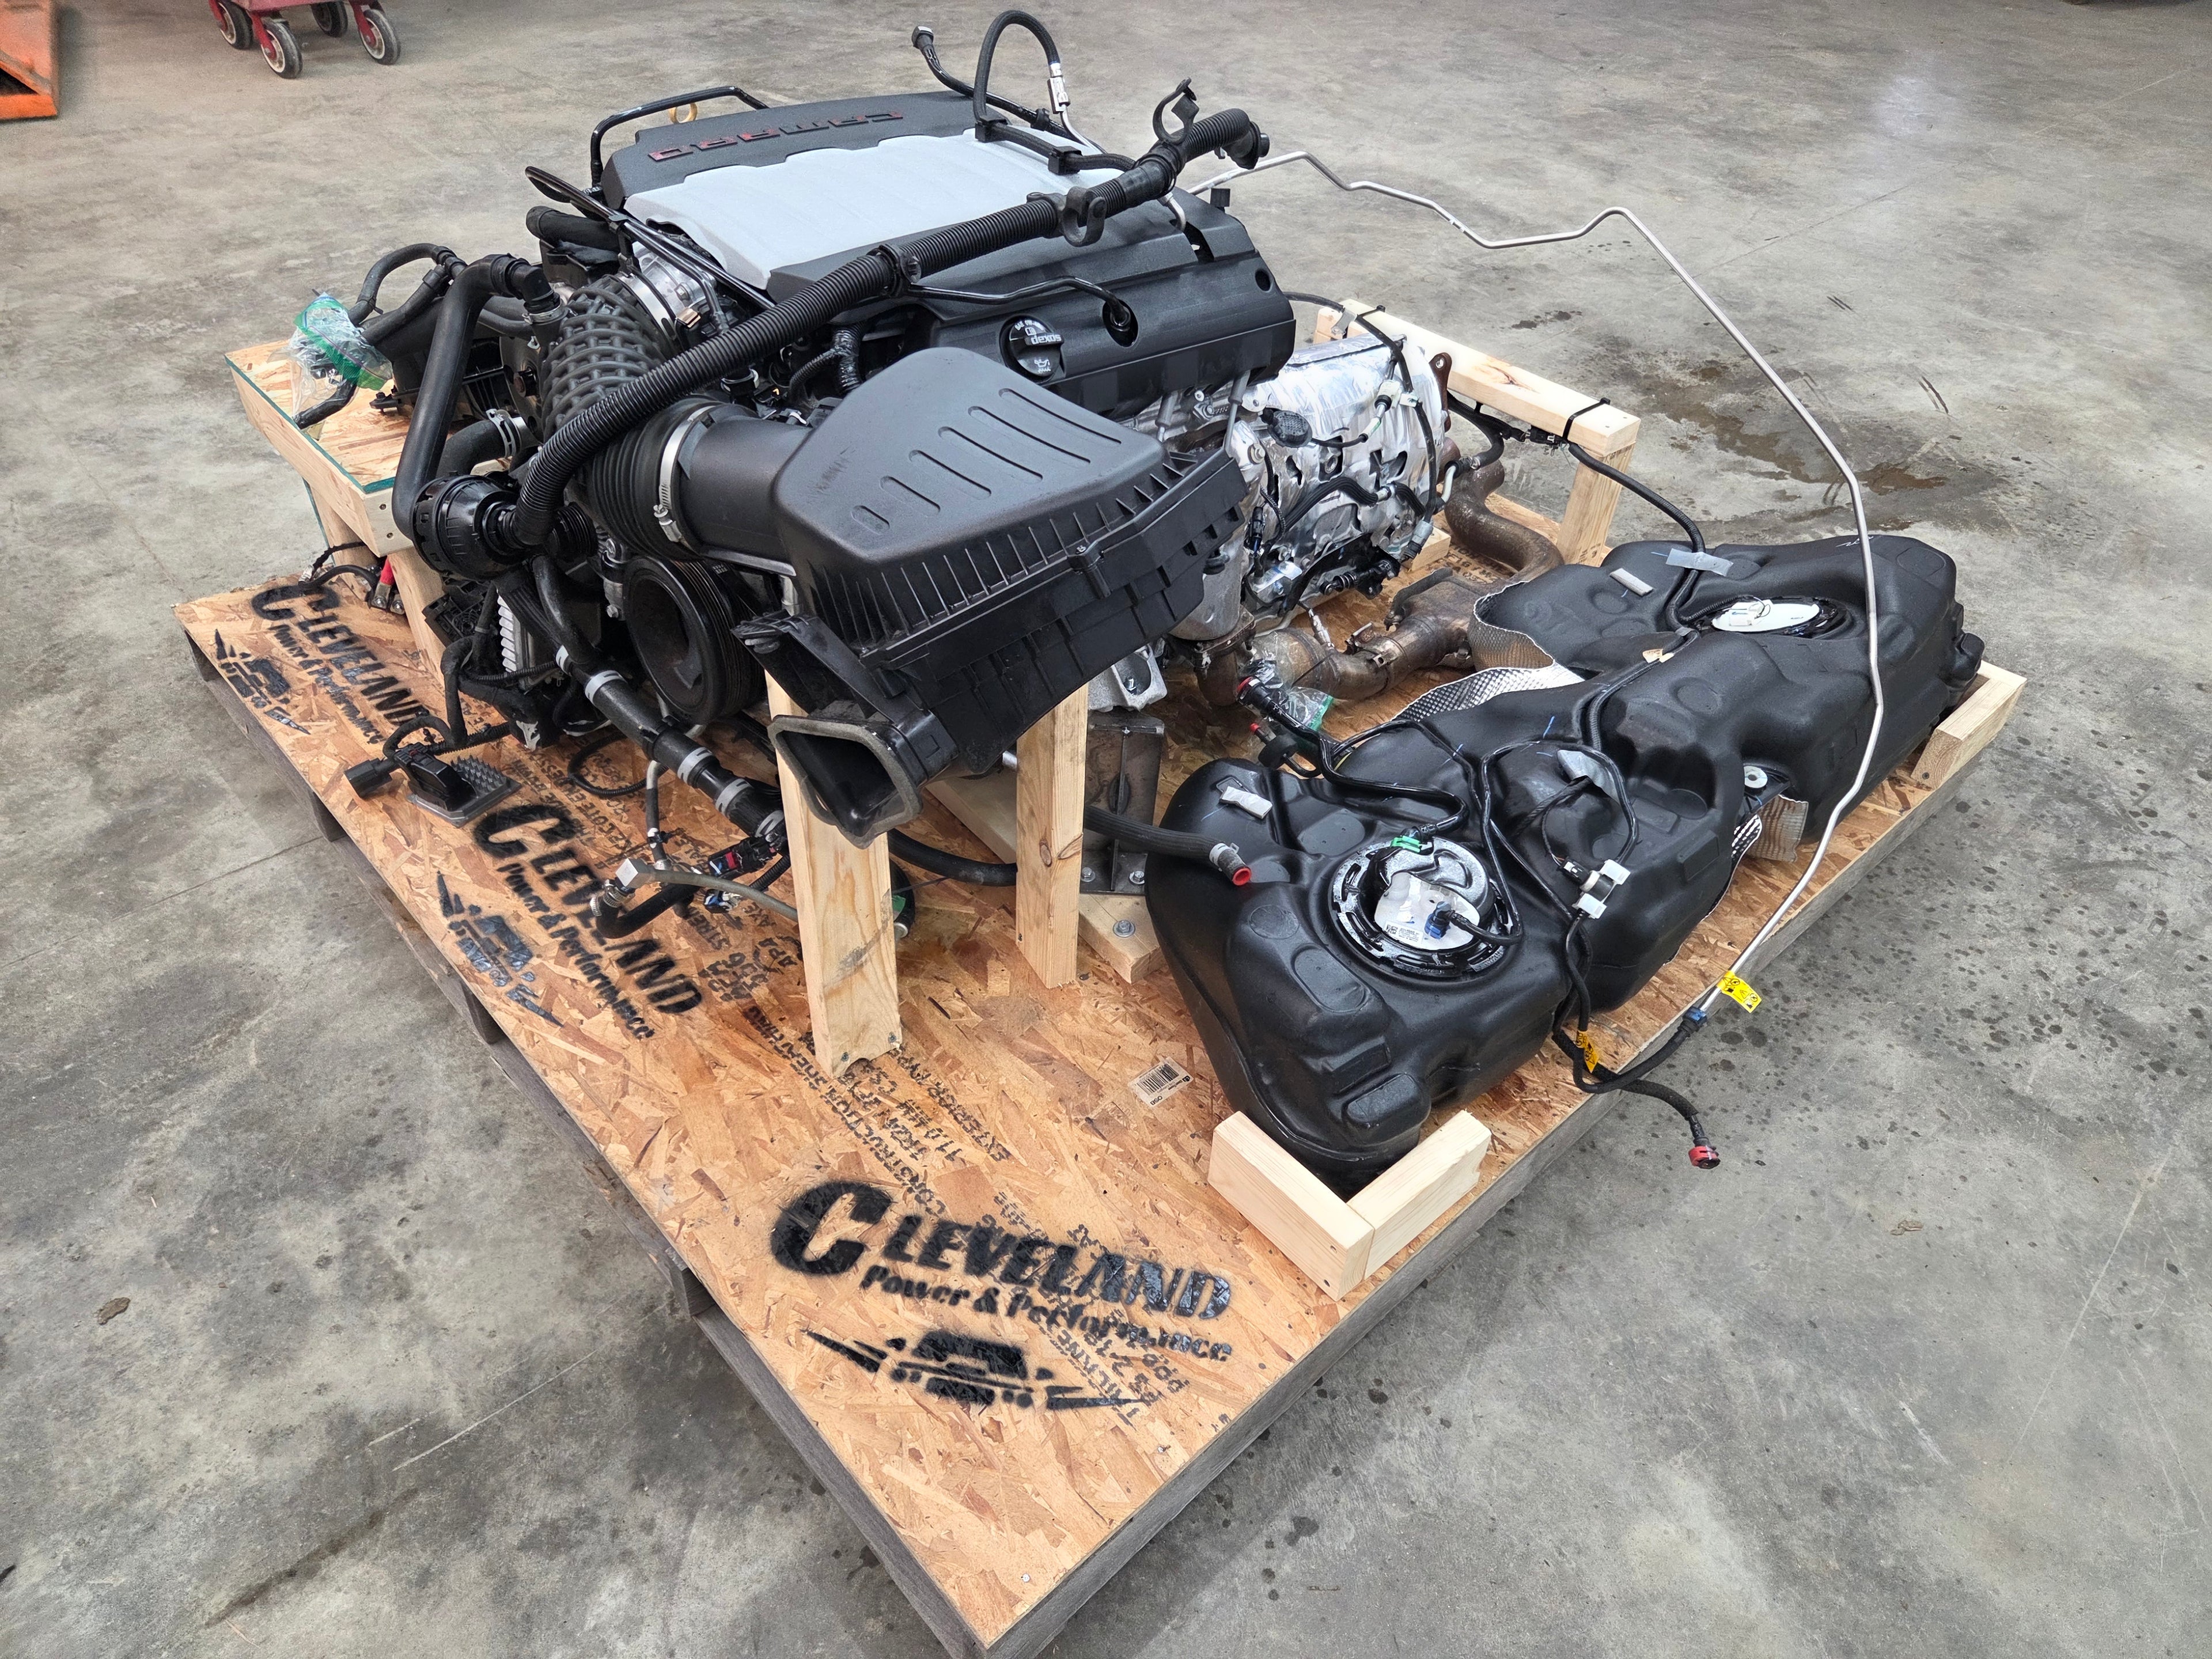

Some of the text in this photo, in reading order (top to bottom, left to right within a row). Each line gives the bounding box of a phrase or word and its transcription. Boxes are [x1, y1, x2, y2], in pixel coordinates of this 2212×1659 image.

[1031, 334, 1062, 345] dexos
[1150, 1095, 1163, 1105] OSB
[771, 1181, 1232, 1319] CLEVELAND
[860, 1265, 1233, 1362] Power & Performance
